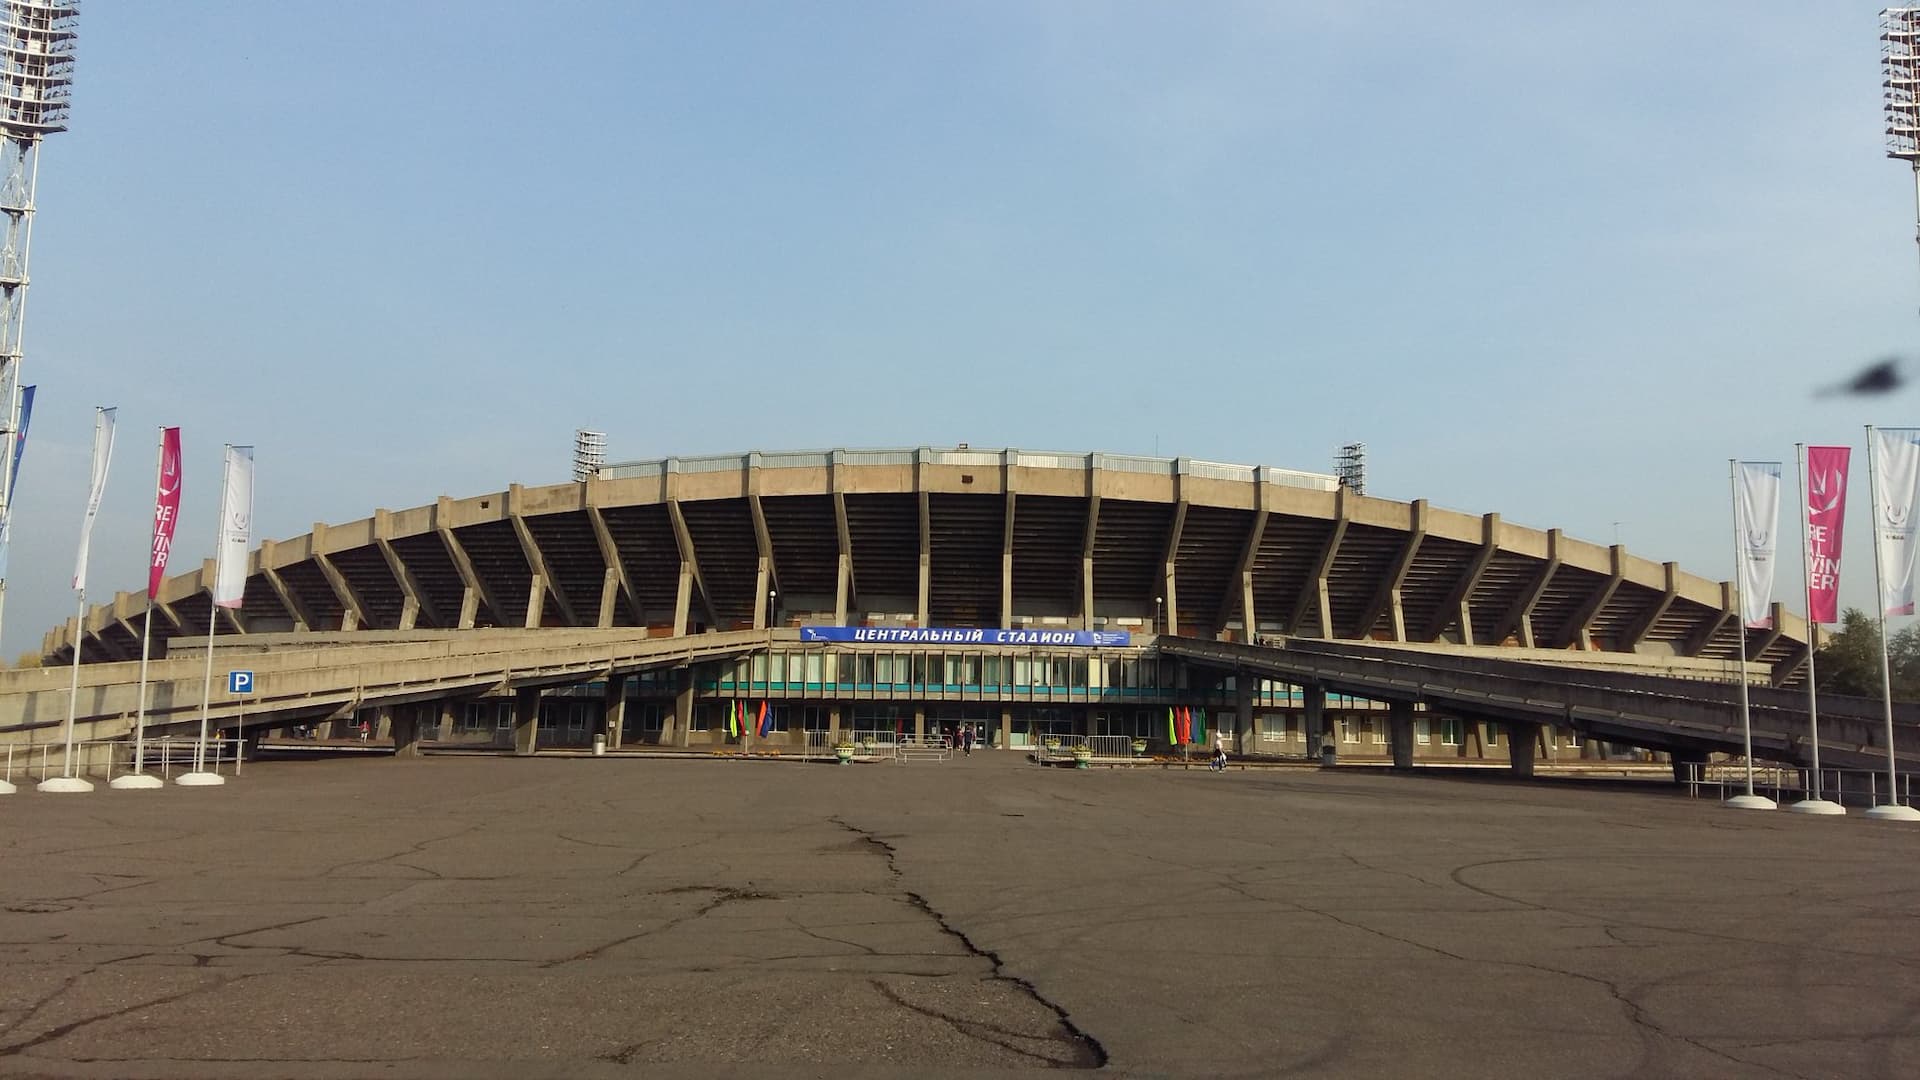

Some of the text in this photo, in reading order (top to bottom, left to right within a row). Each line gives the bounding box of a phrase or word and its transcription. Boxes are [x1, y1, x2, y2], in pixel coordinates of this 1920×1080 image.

[855, 629, 1076, 644] ЦЕНТРАЛЬНЫЙ СТАДИОН
[235, 673, 249, 691] P
